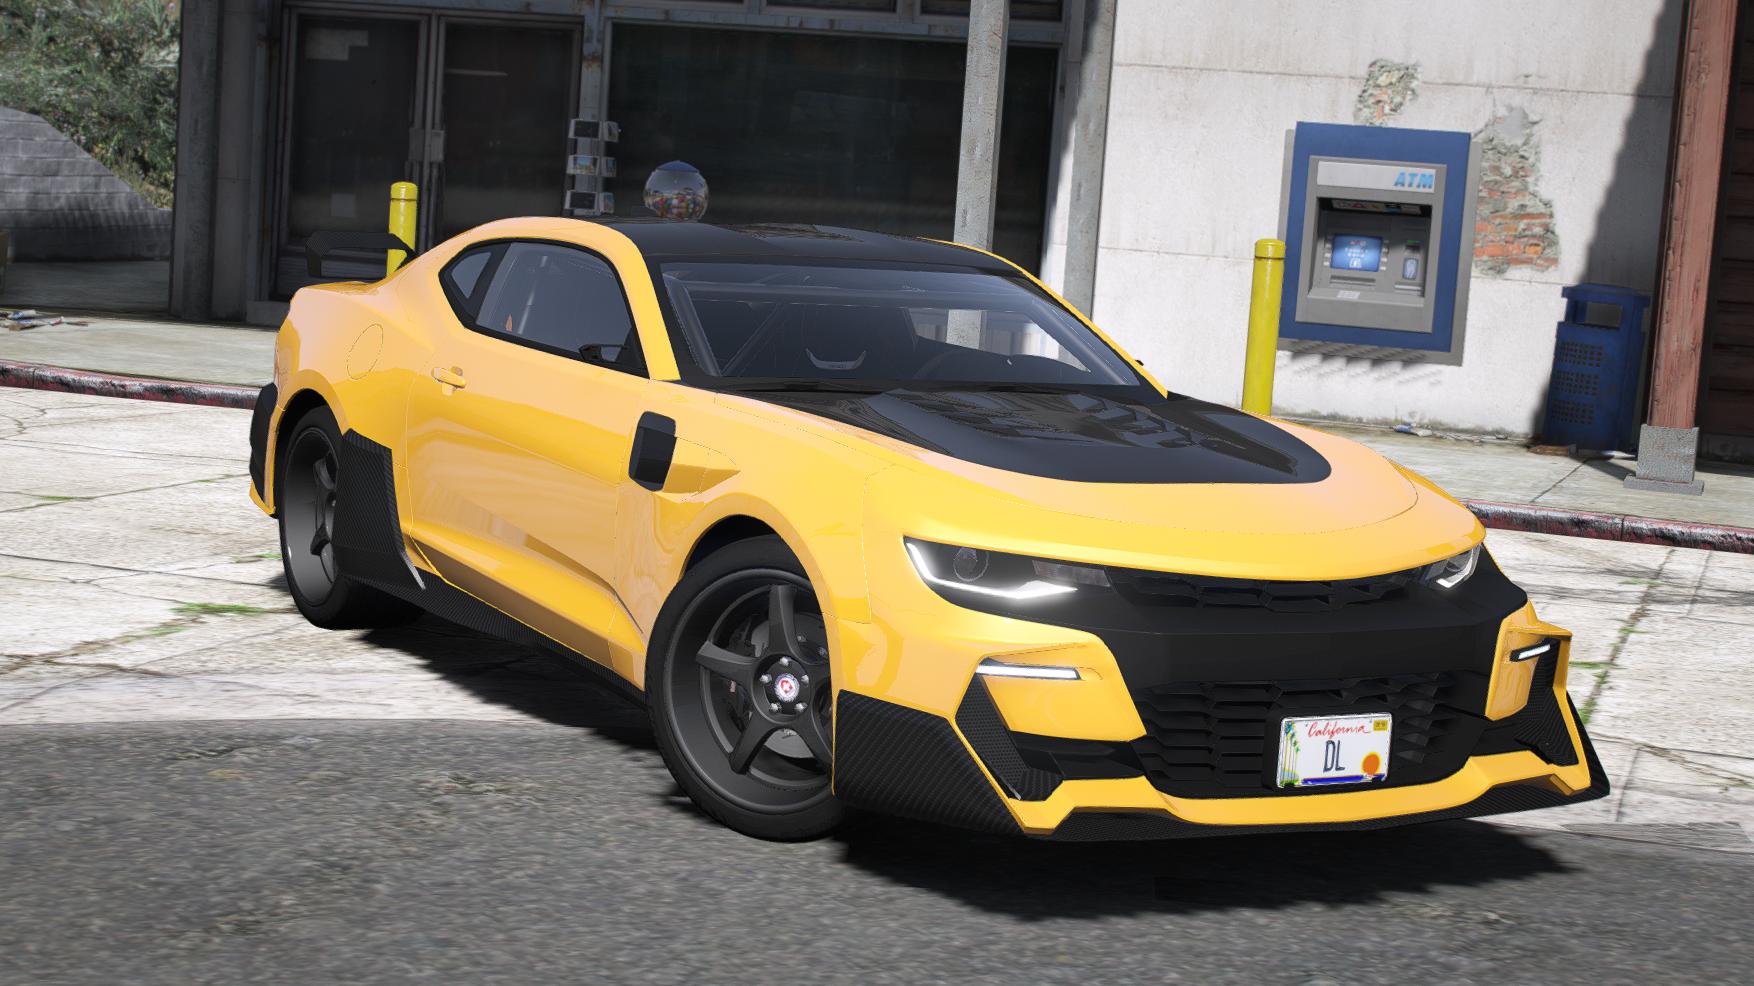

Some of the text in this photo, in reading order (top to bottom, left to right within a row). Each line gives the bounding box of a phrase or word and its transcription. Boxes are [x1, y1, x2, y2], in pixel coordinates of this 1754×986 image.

[1393, 172, 1434, 189] ATM
[1308, 720, 1370, 739] California
[1323, 740, 1345, 773] DL
